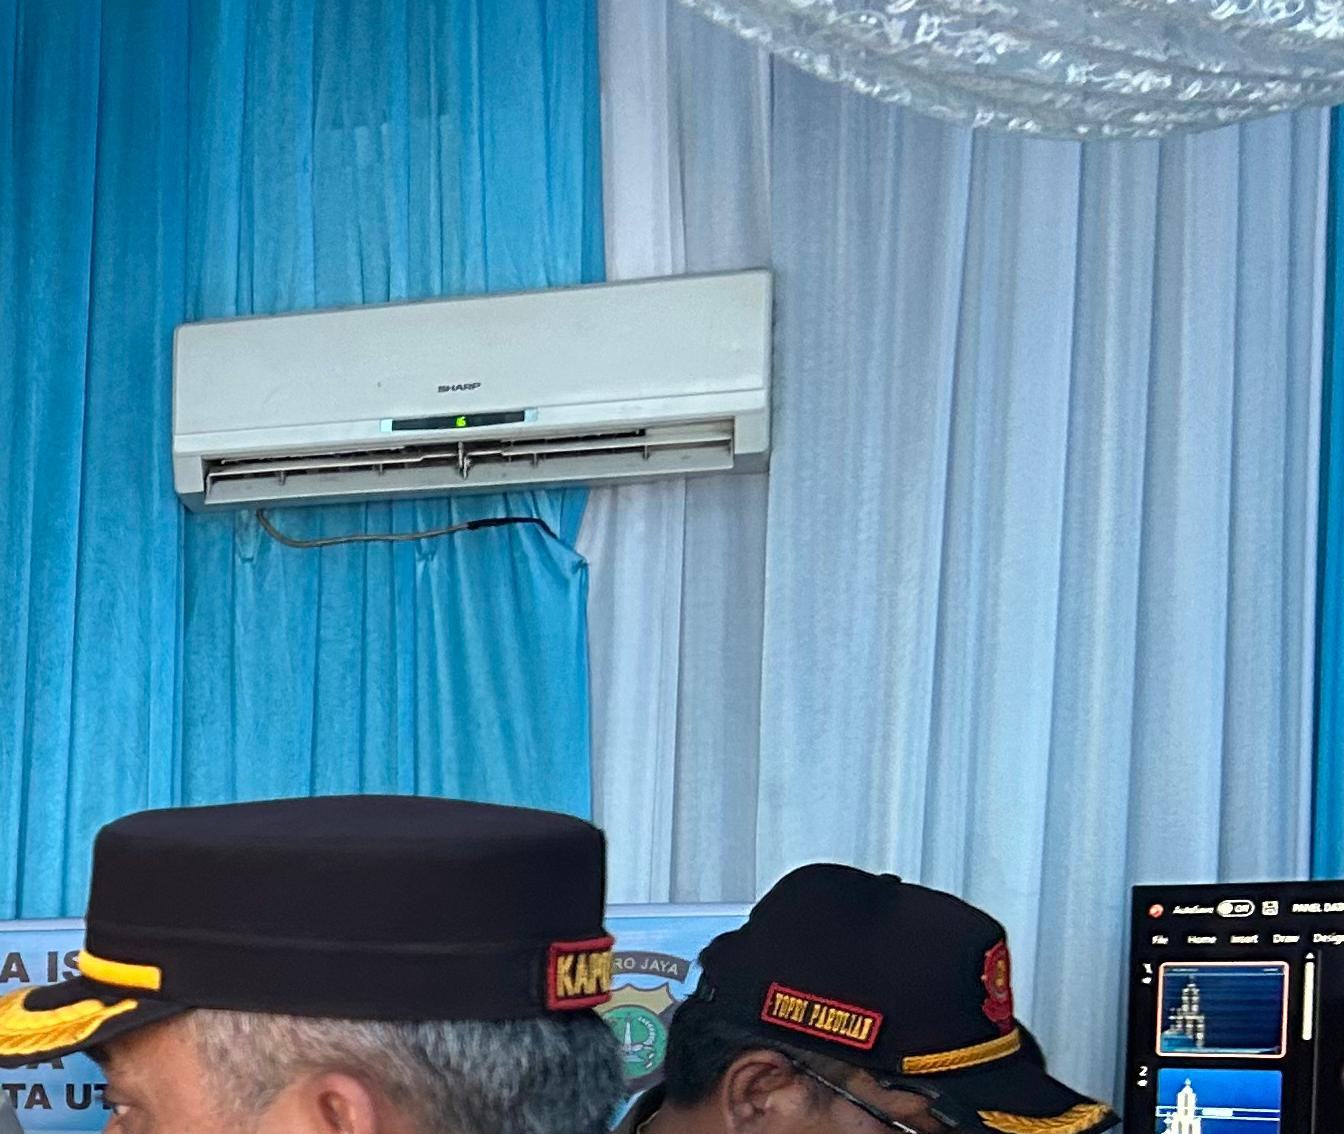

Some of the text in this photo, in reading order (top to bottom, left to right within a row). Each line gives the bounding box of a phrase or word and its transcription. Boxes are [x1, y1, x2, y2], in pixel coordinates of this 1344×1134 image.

[438, 382, 481, 393] SHARP
[641, 958, 679, 976] JAYA
[1138, 1065, 1148, 1077] 2
